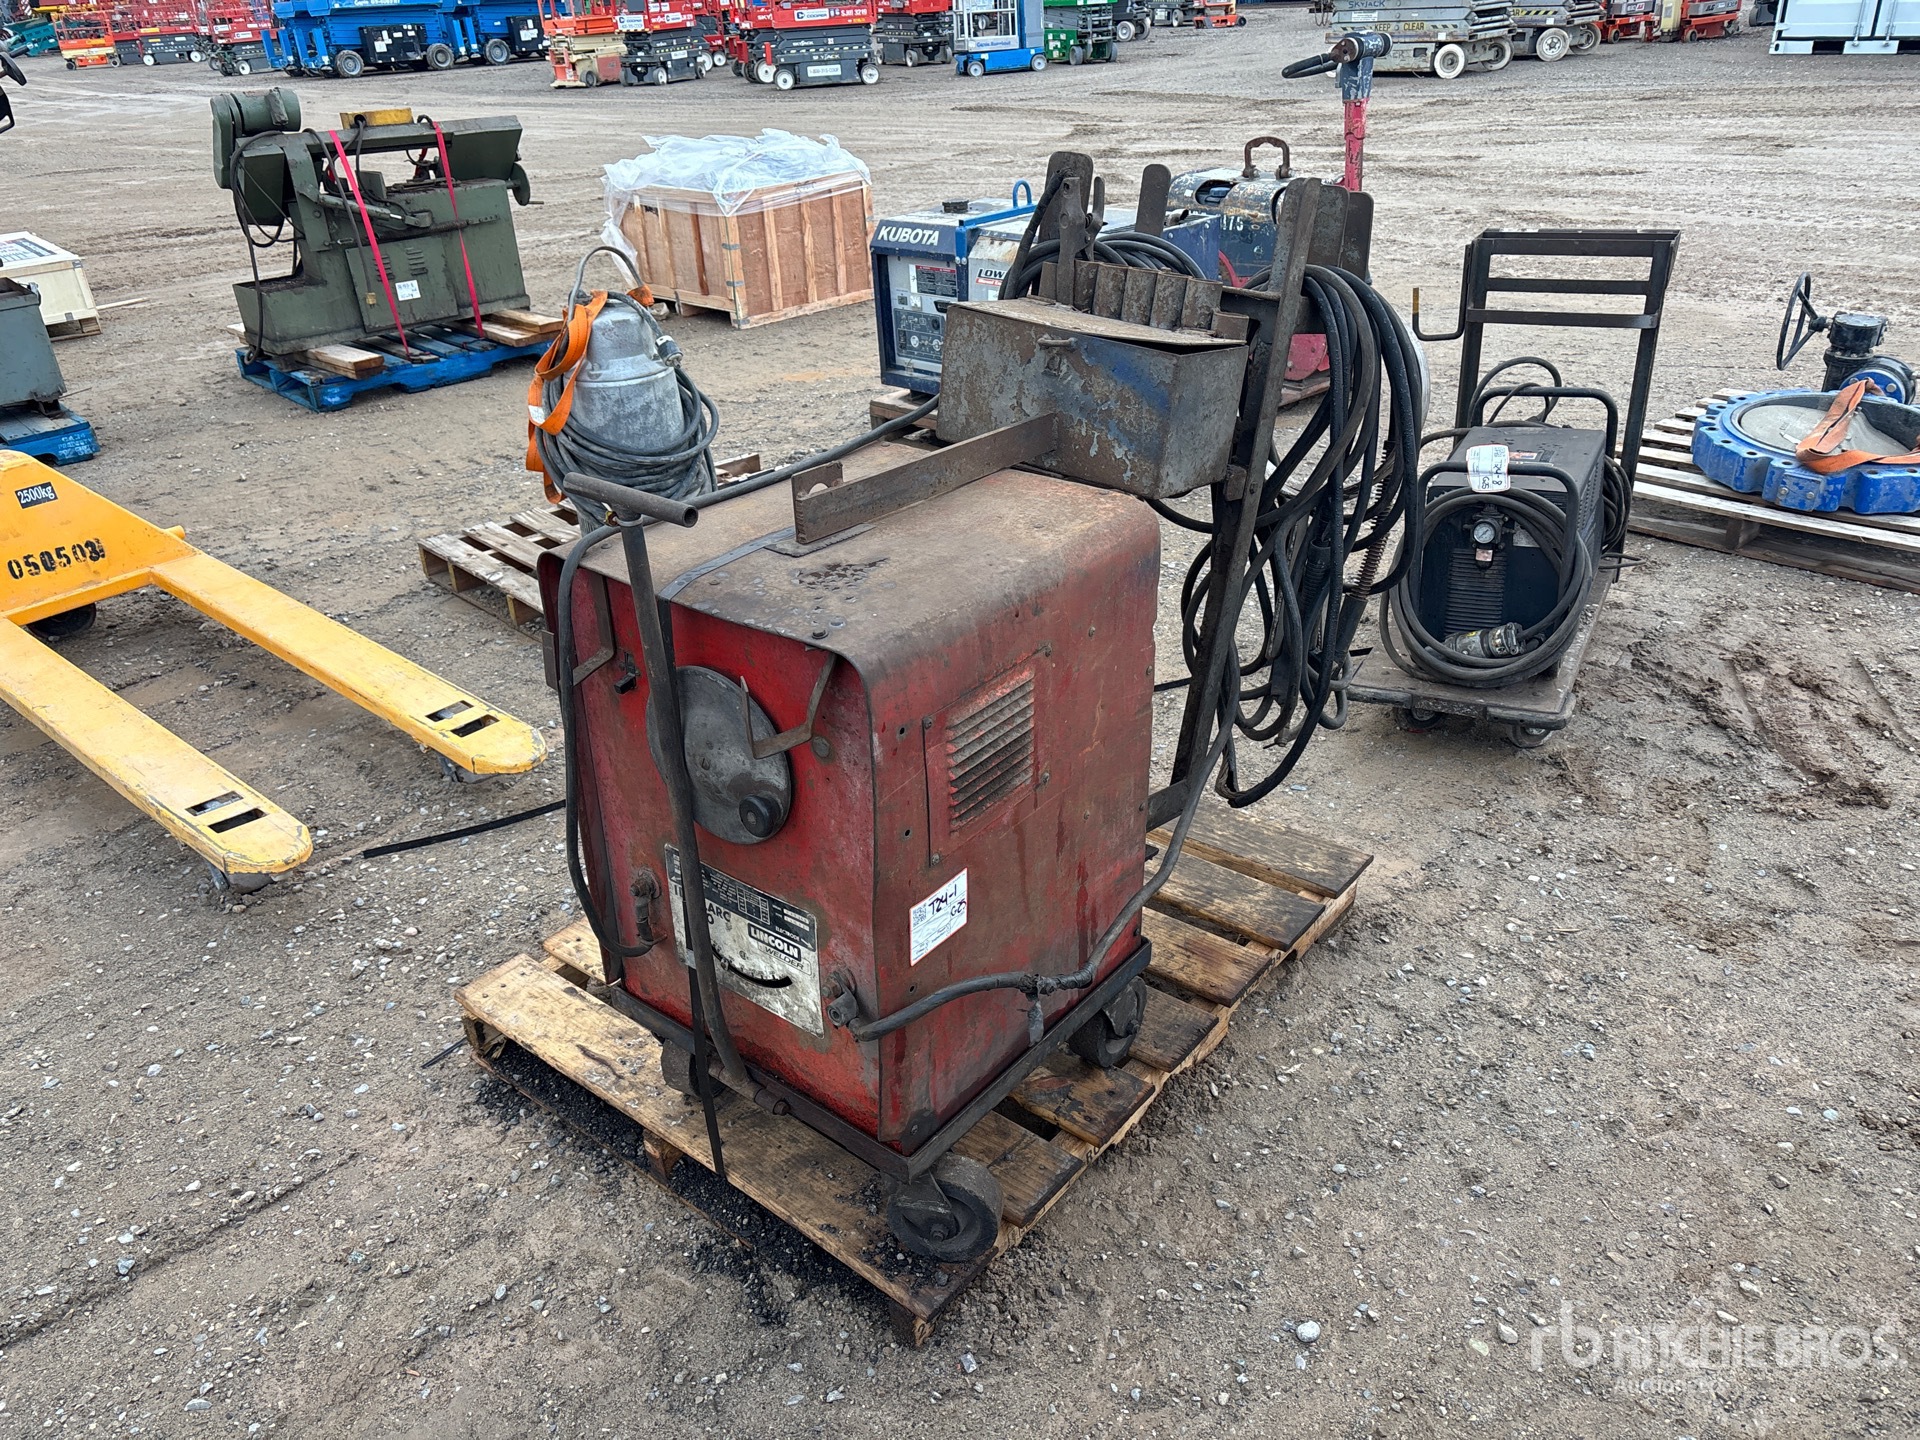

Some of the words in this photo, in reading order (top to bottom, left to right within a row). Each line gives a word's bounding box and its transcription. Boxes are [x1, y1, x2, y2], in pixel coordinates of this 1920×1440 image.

[1348, 0, 1386, 9] SKYJACK
[1374, 23, 1391, 31] KEEP
[1403, 22, 1425, 31] CLEAR
[877, 225, 940, 246] KUBOTA
[978, 269, 1005, 278] LOW
[17, 485, 55, 504] 2500kg
[928, 884, 957, 915] T24-1
[750, 926, 799, 959] LINCOLN
[764, 947, 804, 971] WELDER
